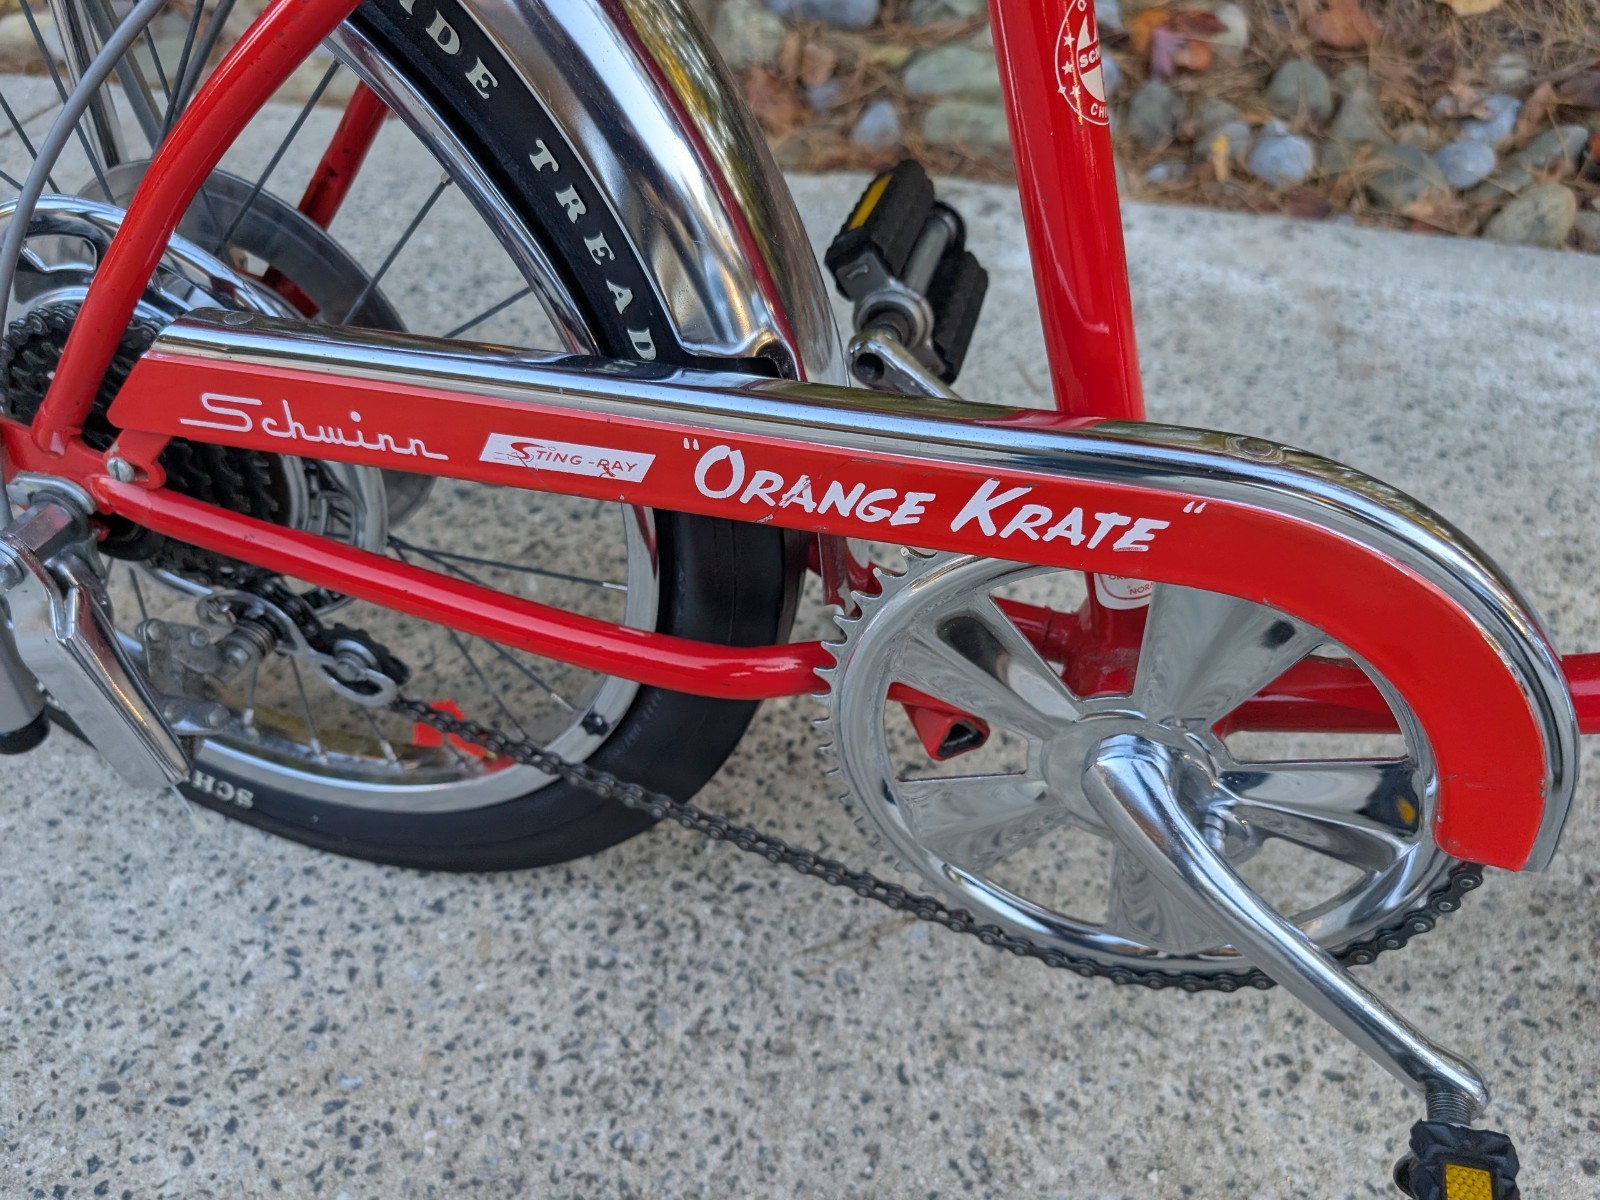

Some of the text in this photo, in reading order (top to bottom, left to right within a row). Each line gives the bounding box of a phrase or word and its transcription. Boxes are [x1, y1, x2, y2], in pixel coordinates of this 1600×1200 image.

[399, 0, 656, 360] DE TREAD
[179, 392, 449, 461] Schwinn
[1129, 583, 1152, 595] NOR
